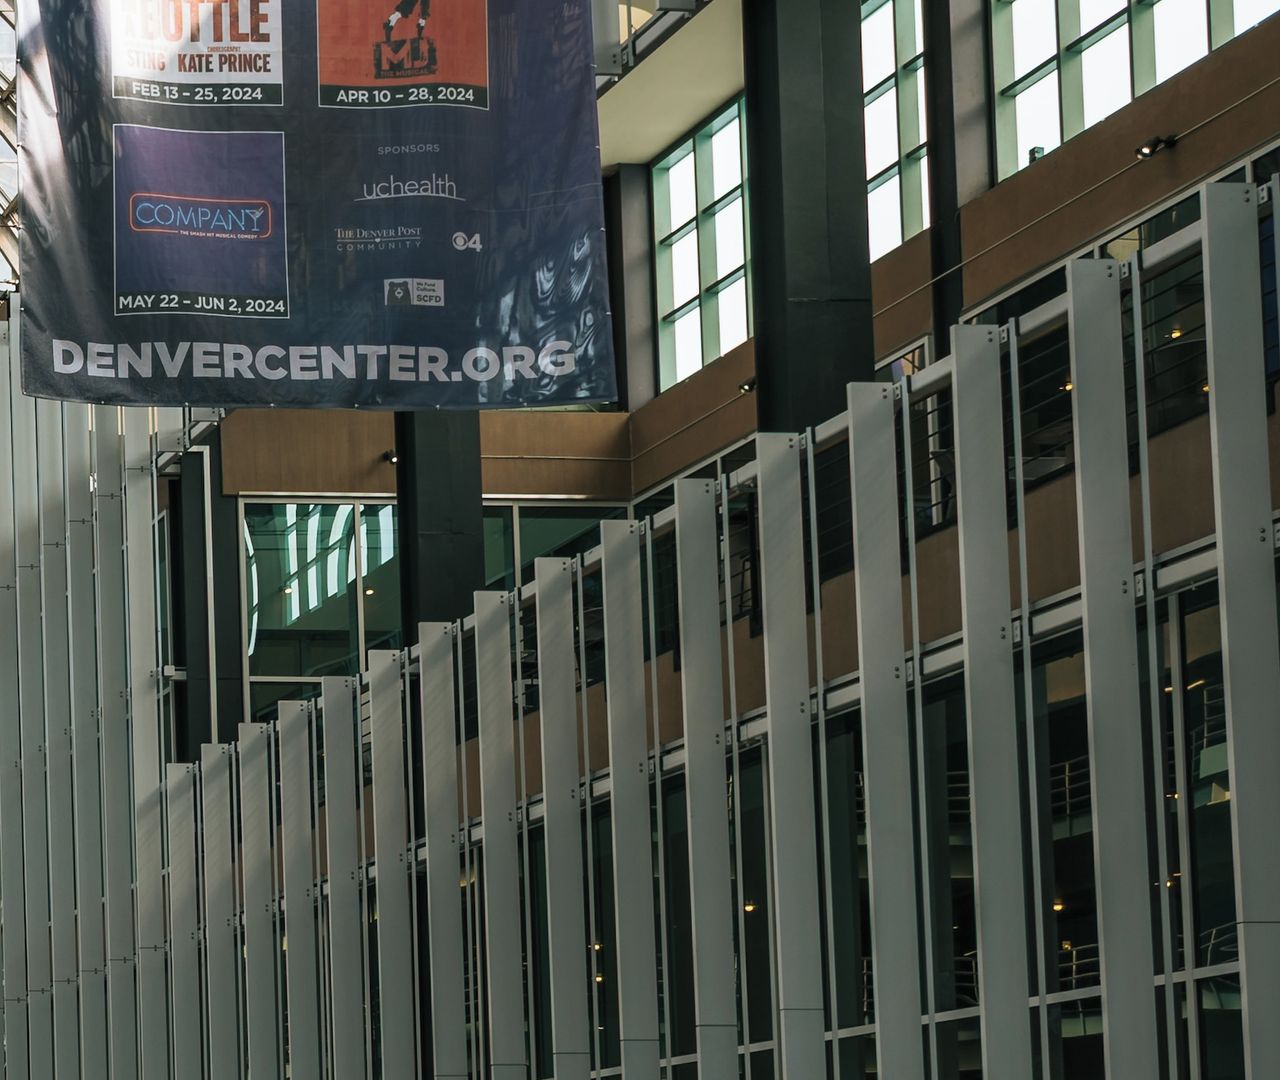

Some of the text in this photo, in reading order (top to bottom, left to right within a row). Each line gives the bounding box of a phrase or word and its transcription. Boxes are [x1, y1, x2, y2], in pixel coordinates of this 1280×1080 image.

[178, 54, 272, 73] KATE PRINCE
[132, 82, 161, 98] FEB
[163, 86, 179, 99] 13
[194, 88, 219, 102] 25,
[222, 88, 263, 100] 2024
[336, 90, 369, 103] APR
[373, 90, 391, 102] 10
[409, 88, 433, 102] 28,
[437, 87, 475, 101] 2024
[378, 143, 440, 156] SPONSORS
[363, 173, 457, 199] uchealth
[136, 203, 265, 232] COMPANY
[337, 226, 422, 239] THE DENVER POST
[336, 241, 422, 251] COMMUNITY
[119, 295, 156, 309] MAY
[160, 294, 179, 308] 22
[194, 297, 225, 311] JUN
[228, 299, 242, 313] 2,
[246, 299, 286, 312] 2024
[416, 294, 442, 303] SCFD
[51, 338, 576, 382] DENVERCENTER.ORG
